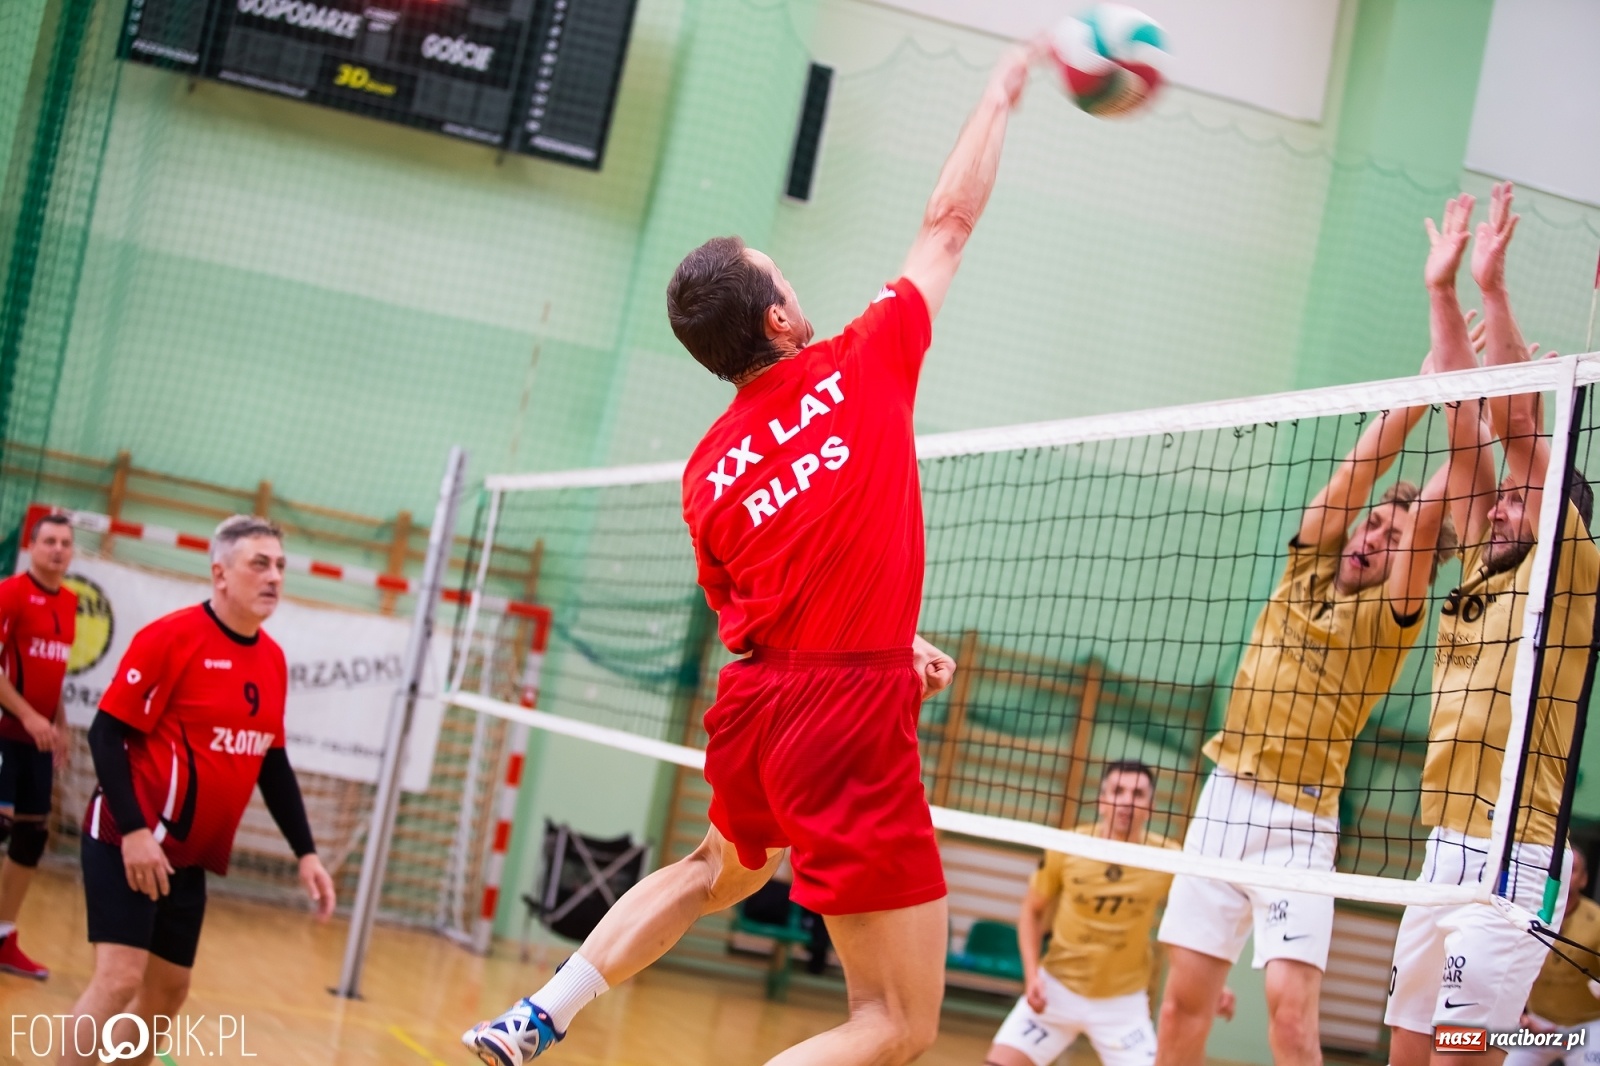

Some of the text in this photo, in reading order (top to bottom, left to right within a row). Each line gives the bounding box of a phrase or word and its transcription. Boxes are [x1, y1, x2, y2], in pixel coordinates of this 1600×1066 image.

[421, 33, 495, 71] GOŚCIE
[706, 371, 845, 501] XX LAT
[742, 435, 850, 527] RLPS
[244, 682, 260, 717] 9
[1094, 895, 1124, 916] 77
[1023, 1018, 1049, 1045] 77
